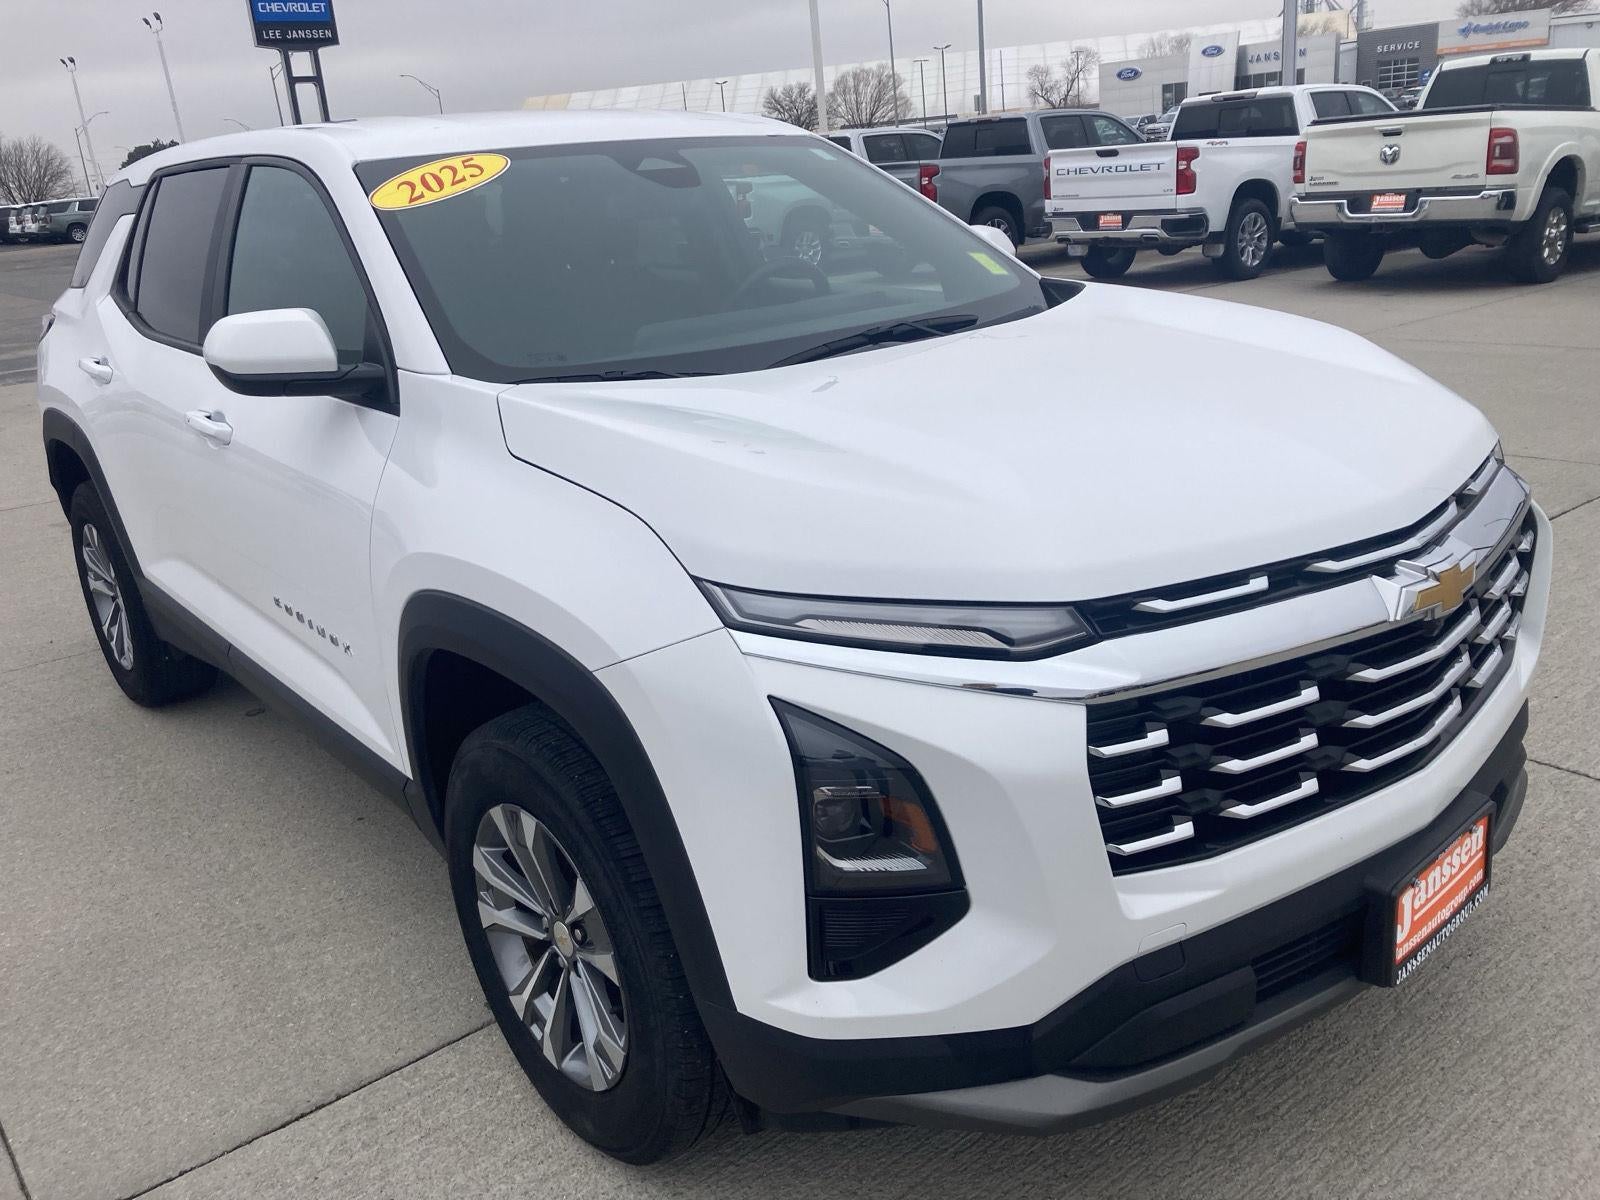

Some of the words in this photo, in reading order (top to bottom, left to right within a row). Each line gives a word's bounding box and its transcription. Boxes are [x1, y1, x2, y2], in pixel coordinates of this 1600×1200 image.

[258, 2, 326, 13] CHEVROLET
[262, 30, 282, 39] LEE
[286, 29, 332, 39] JANSSEN
[1376, 40, 1421, 53] SERVICE
[1248, 48, 1307, 64] JANSN
[1056, 162, 1166, 176] CHEVROLET
[396, 157, 484, 204] 2025
[1396, 824, 1485, 945] Janssen
[1396, 883, 1490, 986] JANSSENAUTOGROUP.COM
